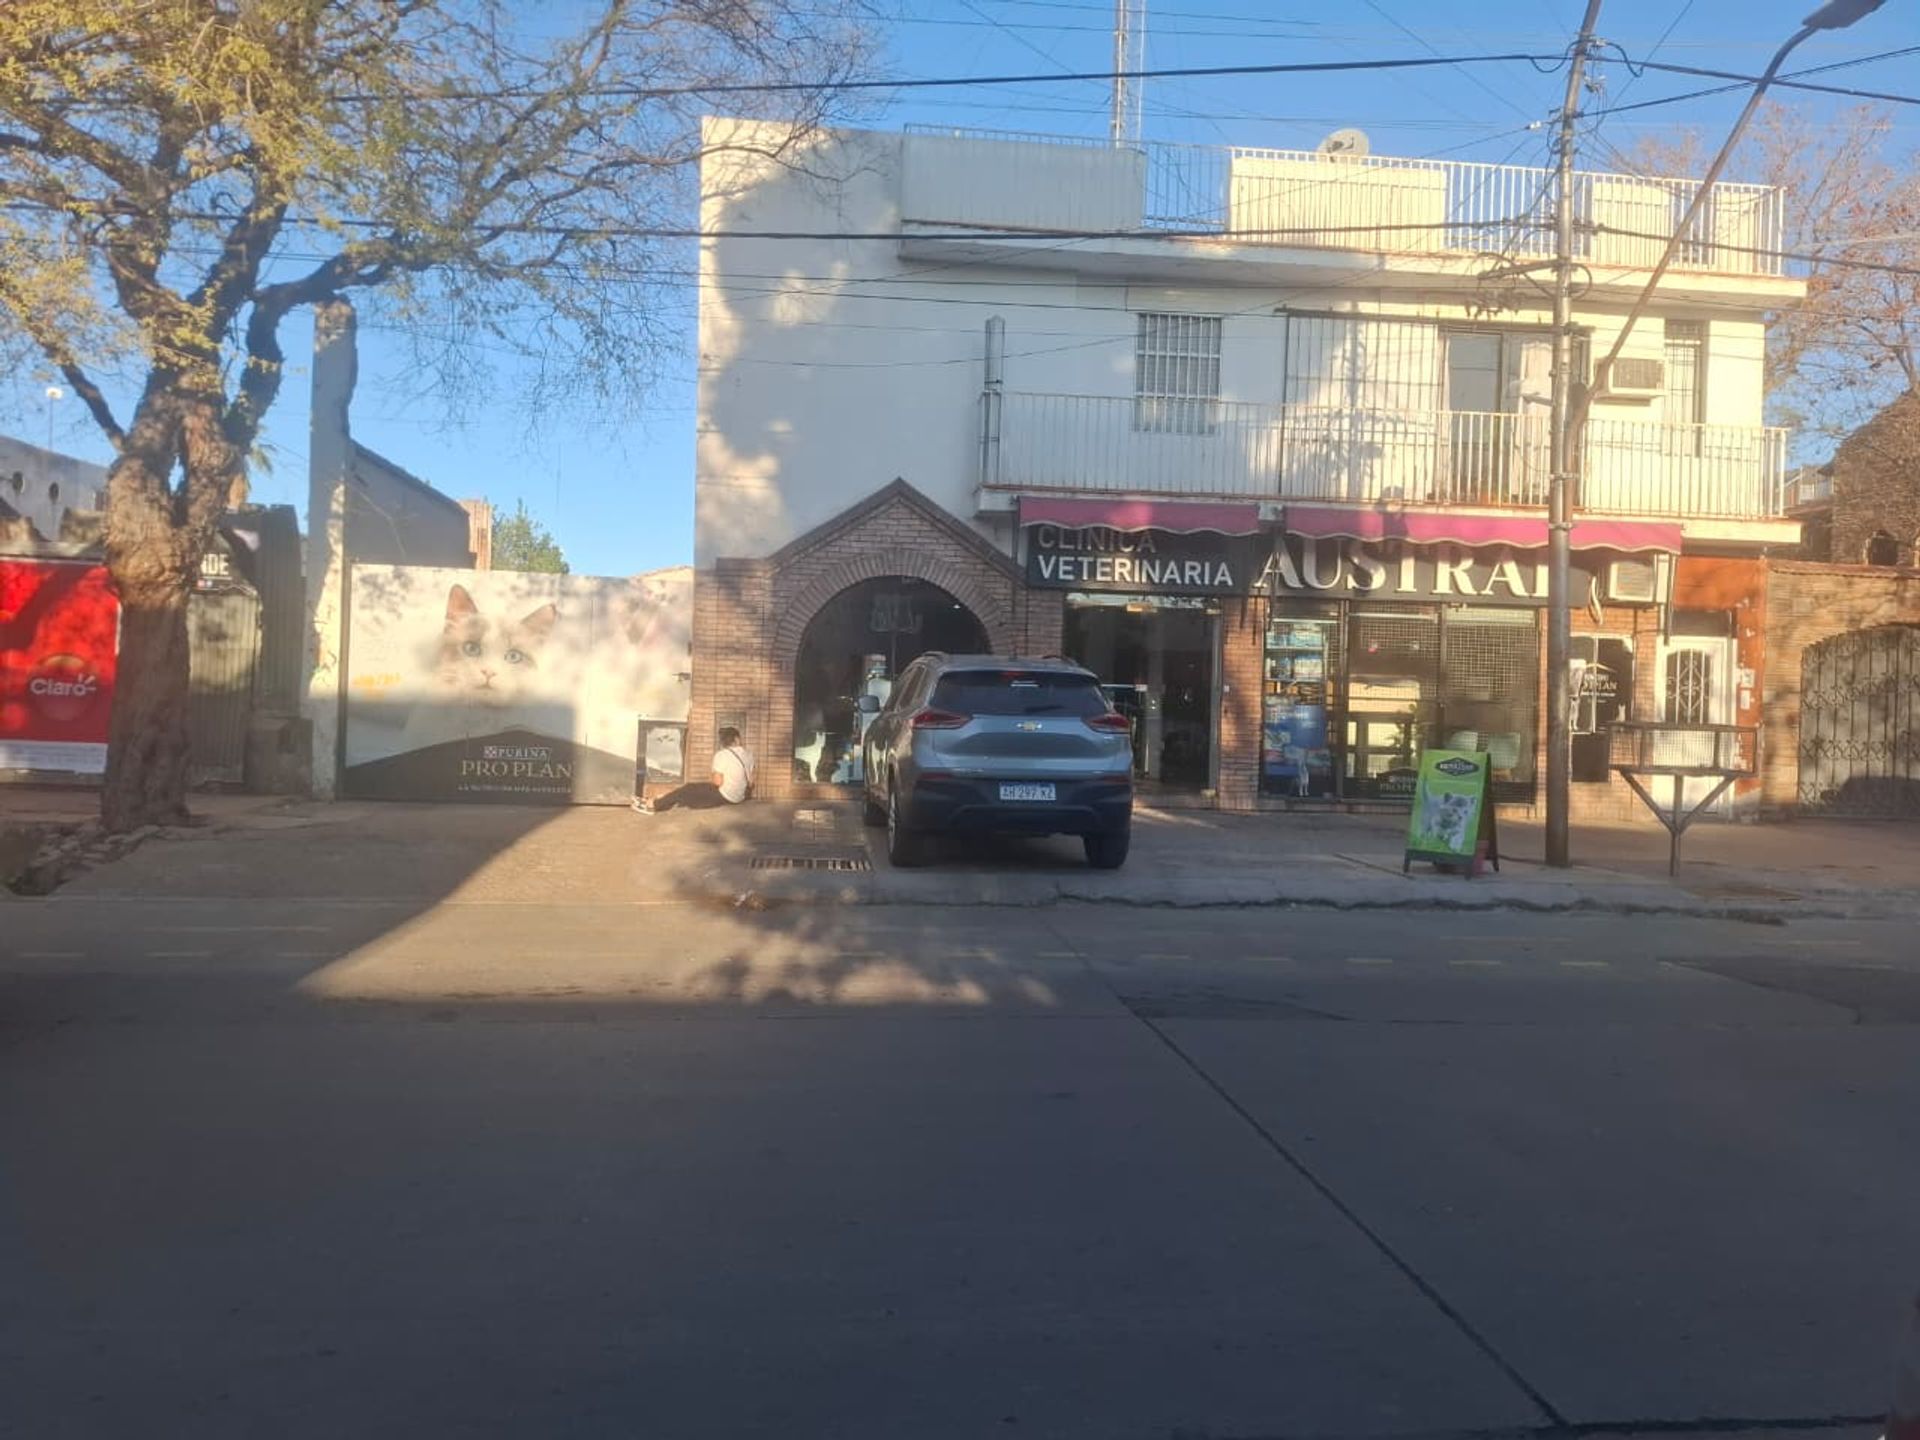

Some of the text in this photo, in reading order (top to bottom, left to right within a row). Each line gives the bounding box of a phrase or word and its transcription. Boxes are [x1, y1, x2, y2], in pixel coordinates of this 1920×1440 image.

[1037, 554, 1234, 587] VETERINARIA
[30, 677, 88, 697] Claro
[499, 747, 549, 759] PURINA
[461, 760, 573, 779] PRO PLAN
